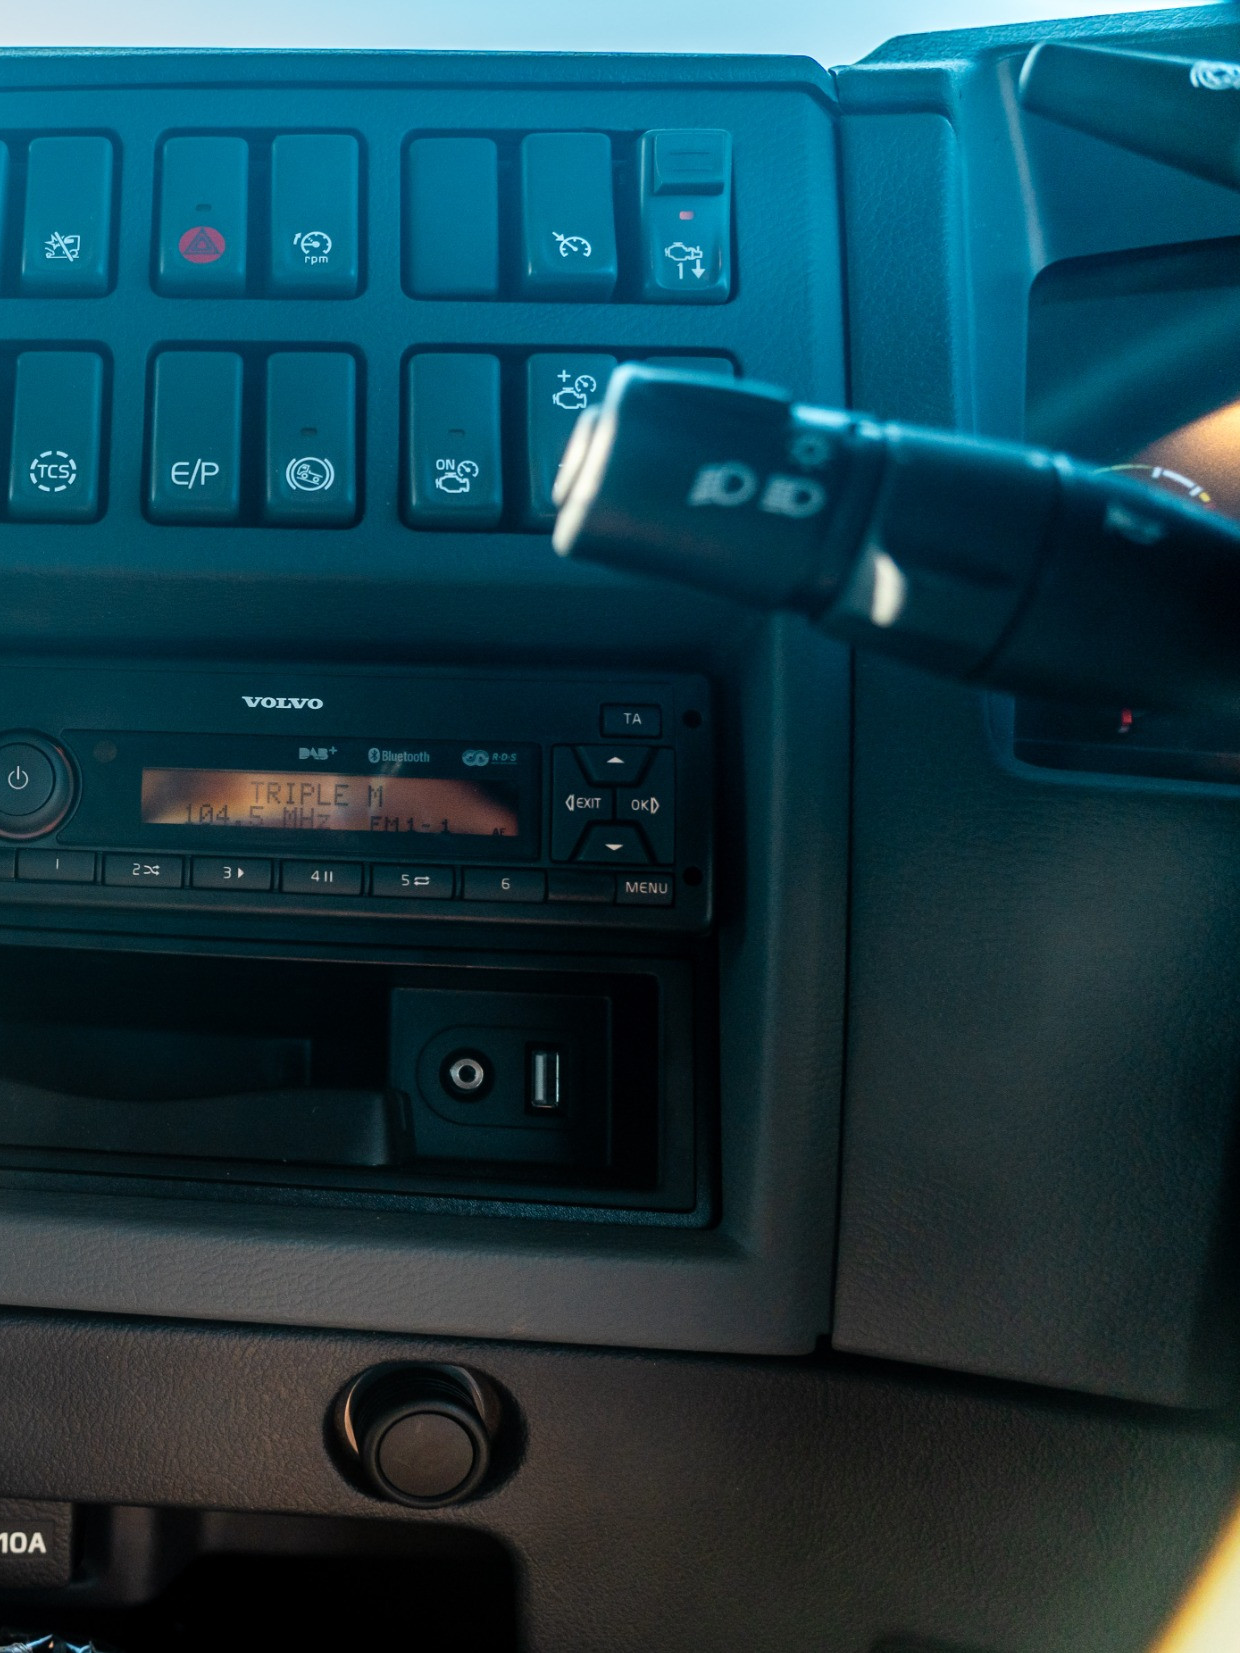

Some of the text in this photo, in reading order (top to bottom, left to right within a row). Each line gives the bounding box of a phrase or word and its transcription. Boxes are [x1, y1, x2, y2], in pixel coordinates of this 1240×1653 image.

[304, 255, 329, 265] rpm
[37, 464, 70, 479] TCS
[435, 459, 455, 471] ON
[171, 458, 220, 490] E/P
[241, 695, 324, 710] VOLVO
[623, 712, 642, 725] TA
[298, 746, 338, 761] DAB+
[381, 750, 430, 763] Bluetooth
[251, 780, 383, 808] TRIPLE M
[576, 797, 601, 810] EXIT
[630, 799, 650, 812] OK
[186, 803, 264, 827] 104.5
[283, 806, 331, 829] MHz
[132, 863, 141, 876] 2
[223, 866, 232, 880] 3
[311, 870, 321, 883] 4
[401, 874, 410, 887] 5
[501, 878, 510, 891] 6
[625, 881, 669, 895] MENU
